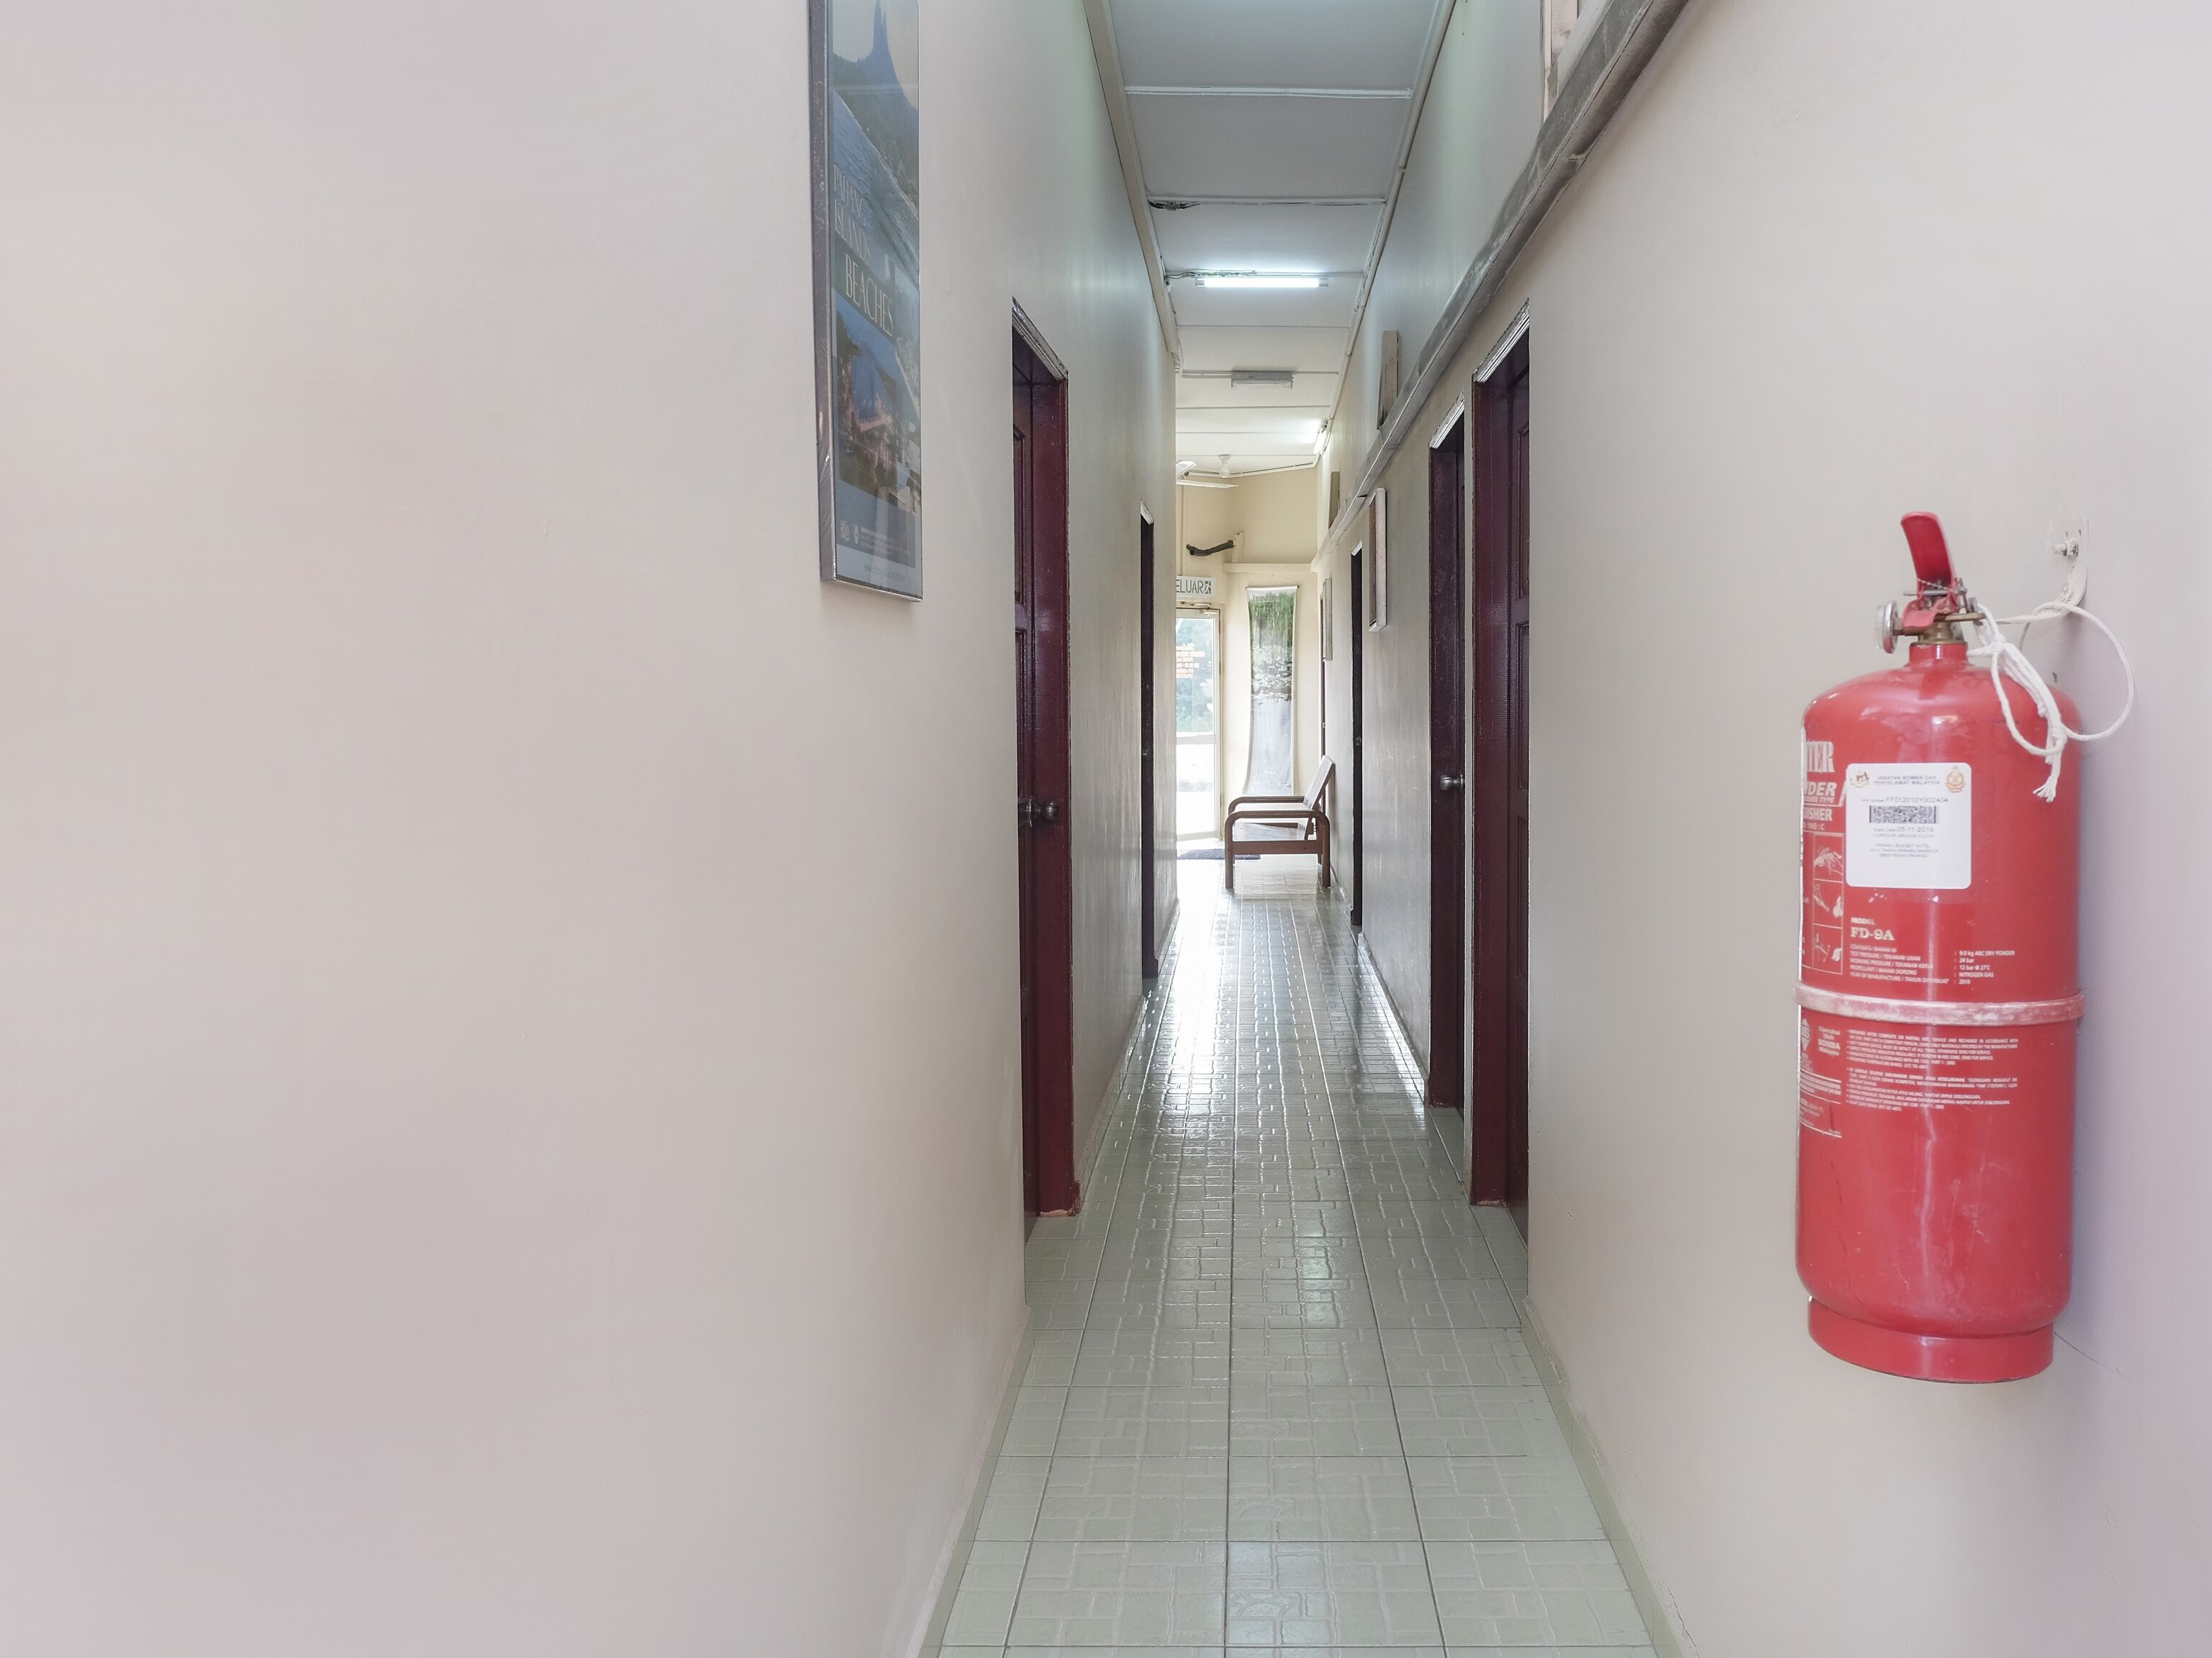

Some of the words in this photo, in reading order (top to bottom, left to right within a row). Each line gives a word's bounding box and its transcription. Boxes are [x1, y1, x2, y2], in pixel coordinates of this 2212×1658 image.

[835, 164, 866, 226] PAHANG
[835, 199, 871, 266] ISLANDS
[846, 253, 894, 336] BEACHES
[1851, 926, 1895, 941] FD-9A
